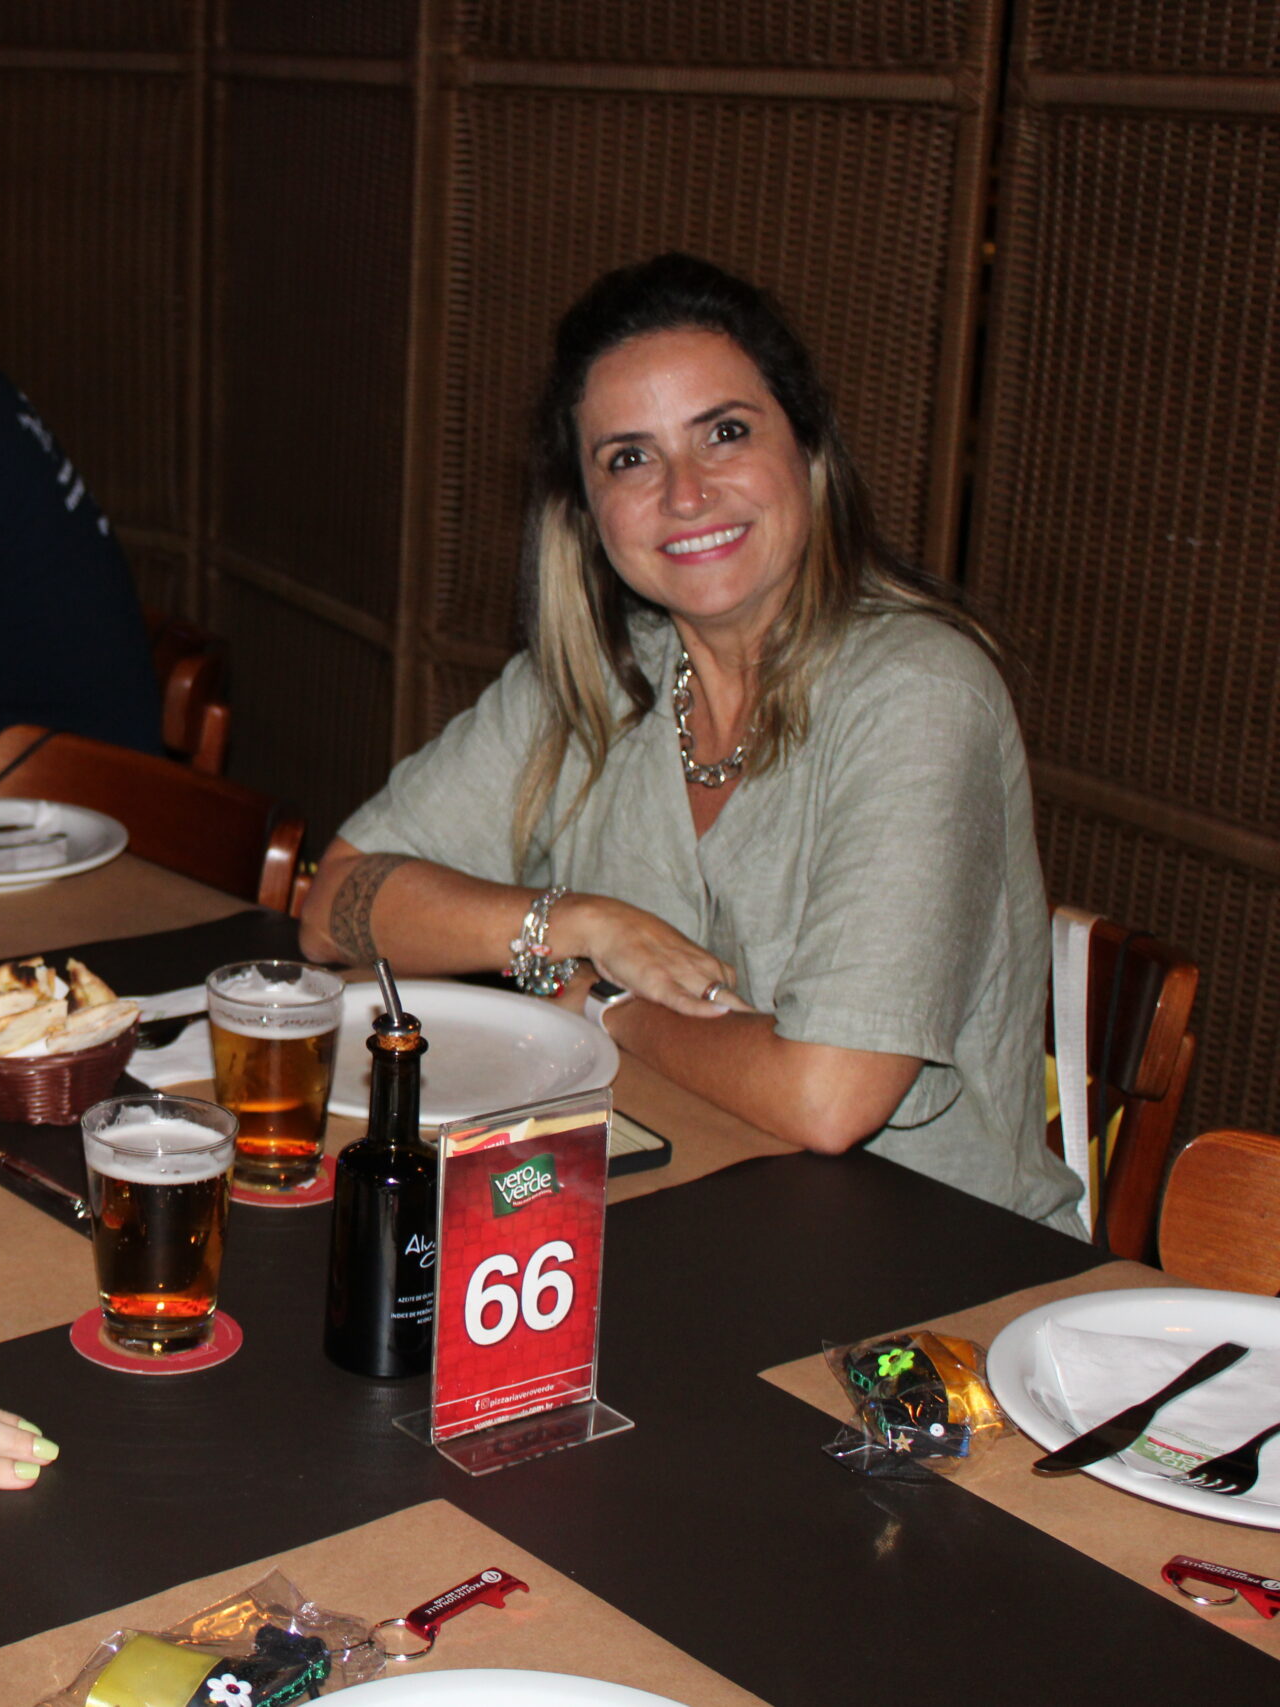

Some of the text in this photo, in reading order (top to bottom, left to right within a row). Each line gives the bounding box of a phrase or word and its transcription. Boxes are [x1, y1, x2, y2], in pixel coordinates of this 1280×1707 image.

[495, 1166, 535, 1192] vero
[502, 1171, 552, 1204] verde
[464, 1240, 575, 1346] 66
[489, 1384, 555, 1408] pizzariaveroverde
